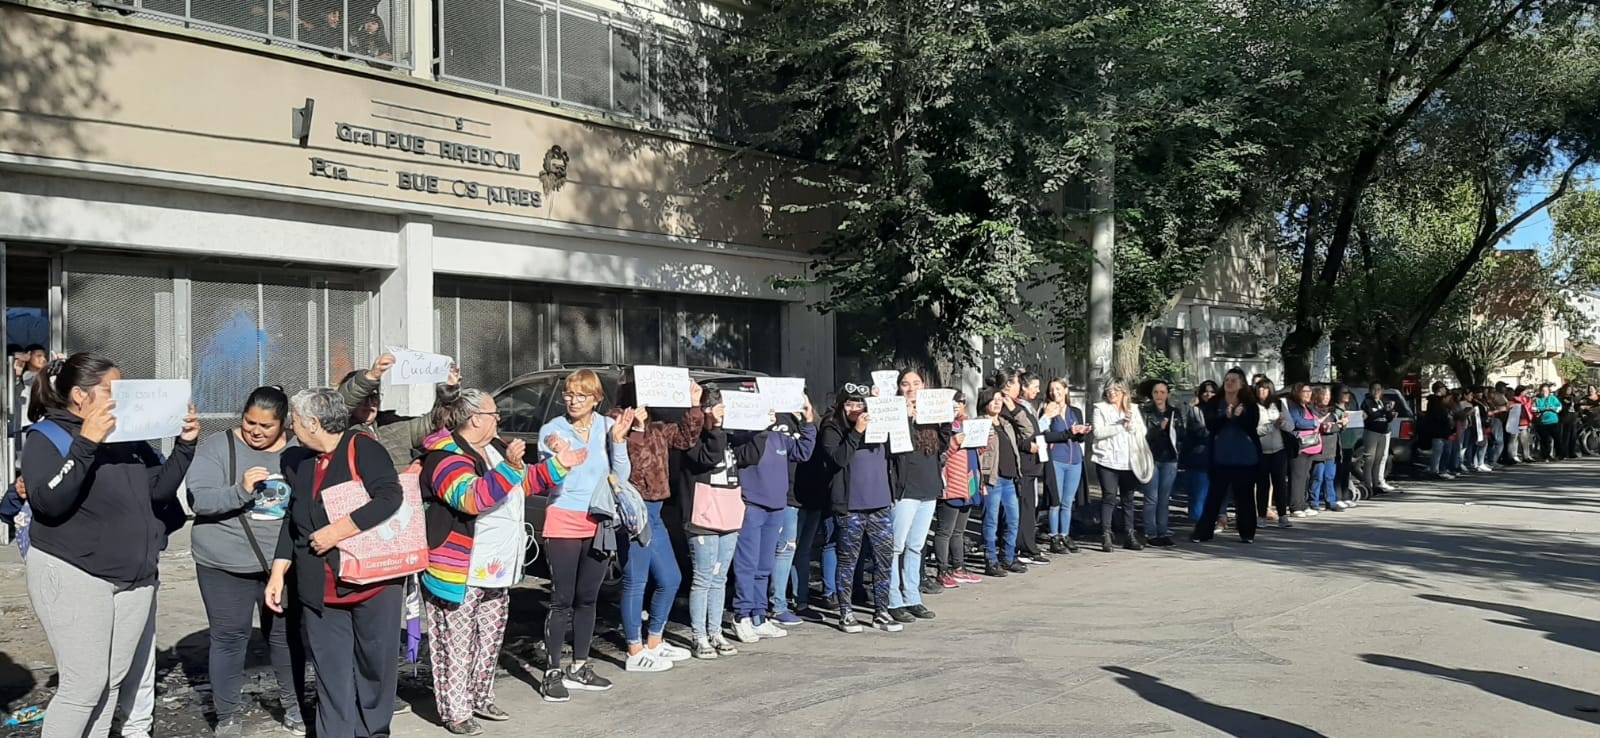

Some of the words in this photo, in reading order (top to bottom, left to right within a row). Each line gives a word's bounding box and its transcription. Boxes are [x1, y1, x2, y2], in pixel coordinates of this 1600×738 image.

[336, 123, 378, 147] Gral
[398, 171, 439, 194] BUE
[487, 185, 542, 208] AIRES
